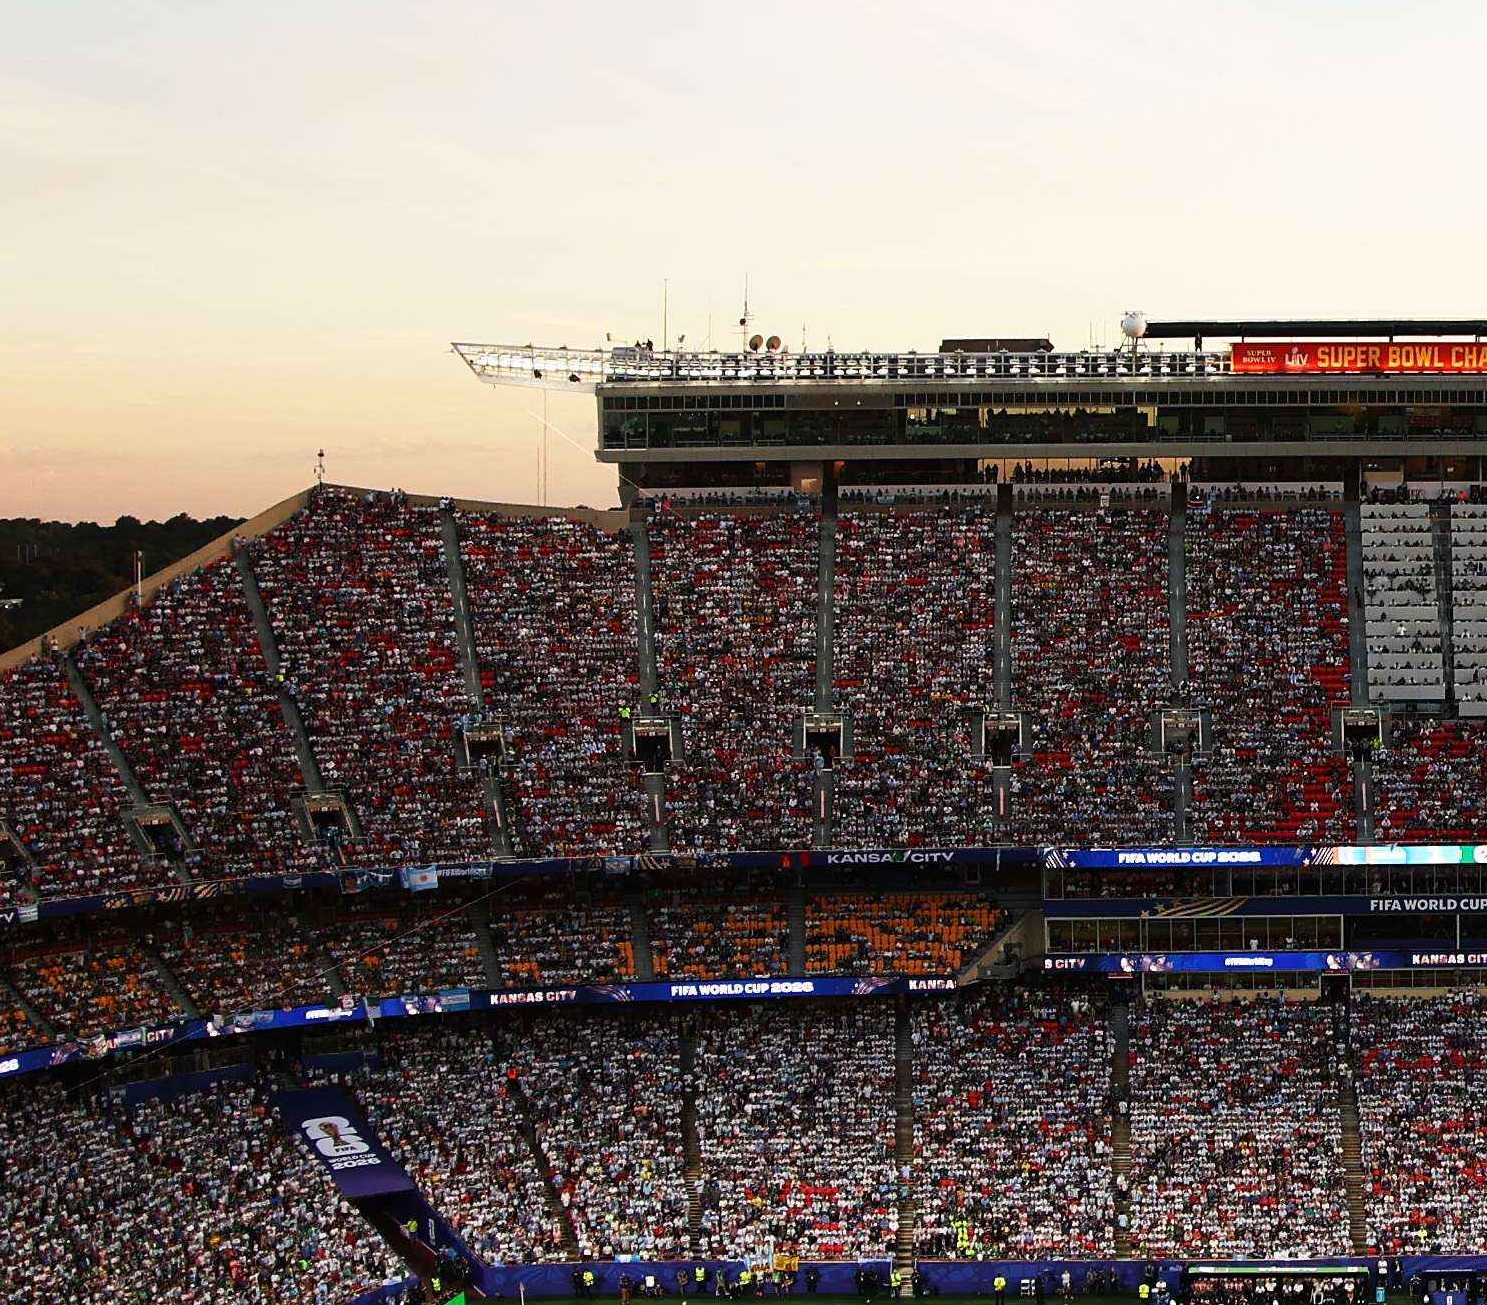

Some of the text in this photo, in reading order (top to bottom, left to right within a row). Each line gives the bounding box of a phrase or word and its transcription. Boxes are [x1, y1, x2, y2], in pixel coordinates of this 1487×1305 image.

[1317, 347, 1380, 368] SUPER
[1388, 347, 1444, 368] BOWL
[828, 852, 954, 863] KANSA CITY
[1118, 852, 1143, 864] FIFA
[1146, 852, 1191, 863] WORLD
[1193, 852, 1216, 863] CUP
[1370, 899, 1400, 911] FIFA
[1402, 899, 1458, 911] WORLD
[1055, 958, 1086, 968] CITY
[1412, 954, 1462, 964] KANSAS
[671, 984, 697, 996] FIFA
[699, 984, 744, 995] WORLD
[746, 983, 769, 994] CUP
[490, 990, 576, 1005] KANSAS CITY
[146, 1028, 174, 1042] CITY
[331, 1157, 381, 1170] 2026
